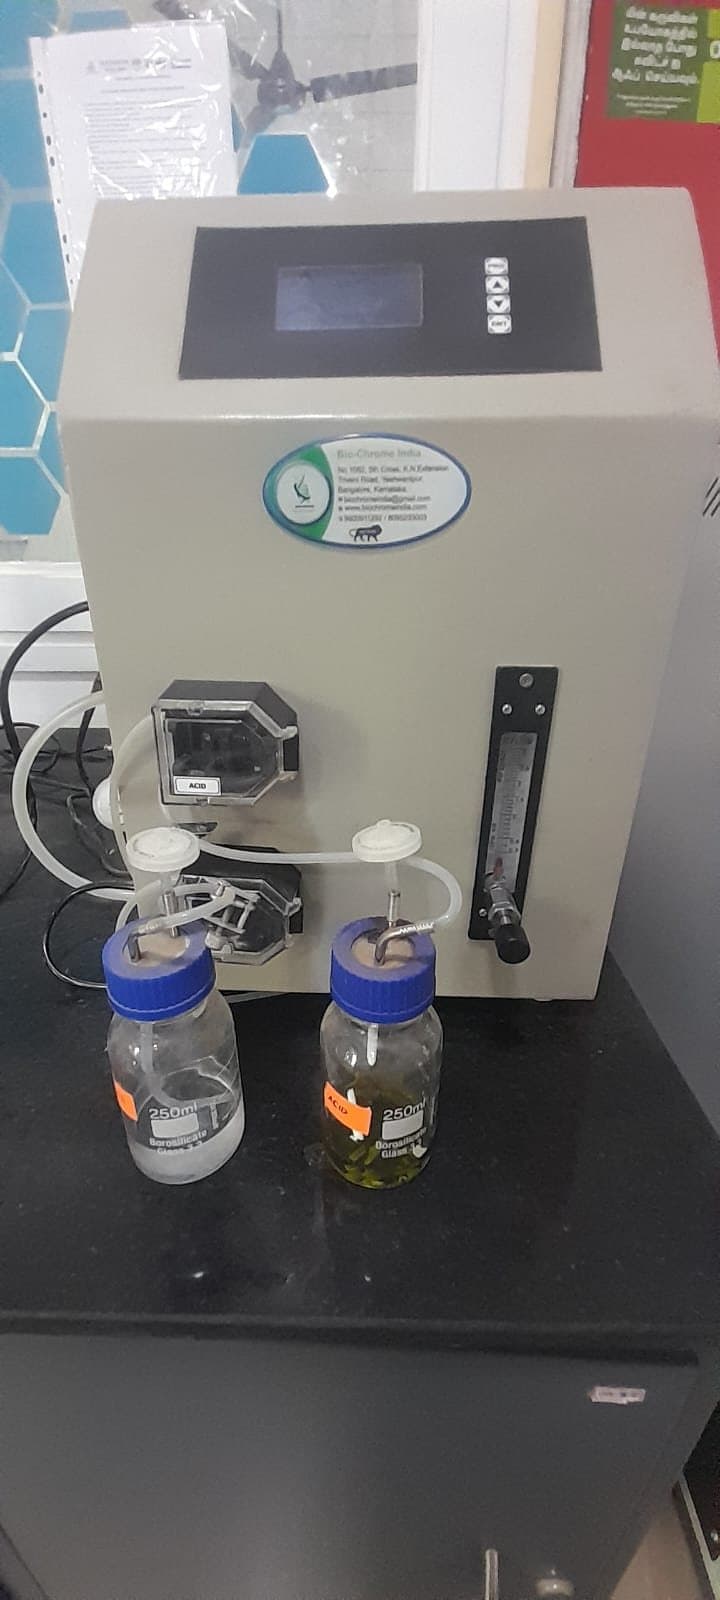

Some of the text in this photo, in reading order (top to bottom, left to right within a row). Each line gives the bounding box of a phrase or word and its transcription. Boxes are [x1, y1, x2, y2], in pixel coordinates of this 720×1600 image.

[337, 447, 422, 458] Bio-Chrome India
[189, 782, 206, 790] ACID
[148, 1102, 198, 1120] 250ml
[328, 1095, 348, 1114] ACID
[382, 1096, 426, 1121] 250ml
[148, 1130, 208, 1147] Borosilicate
[375, 1127, 427, 1150] Borosilicate
[380, 1148, 408, 1159] Glass
